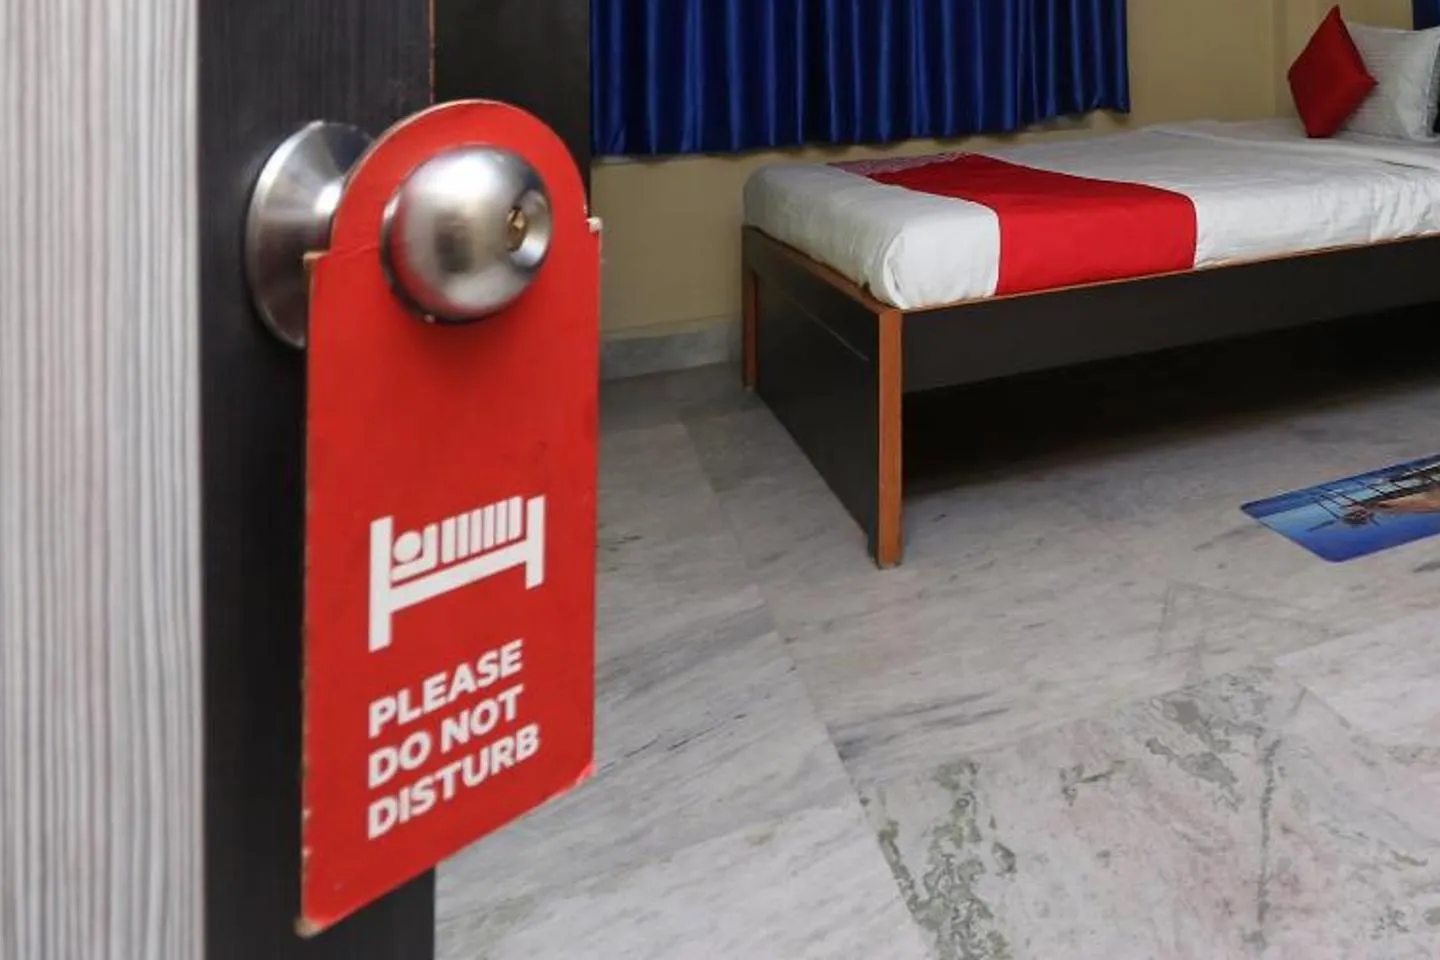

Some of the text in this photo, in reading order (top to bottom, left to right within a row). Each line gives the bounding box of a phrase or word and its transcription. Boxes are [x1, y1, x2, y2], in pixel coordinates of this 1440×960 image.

[368, 638, 523, 738] PLEASE
[368, 684, 524, 789] DO NOT
[368, 723, 540, 840] DISTURB
